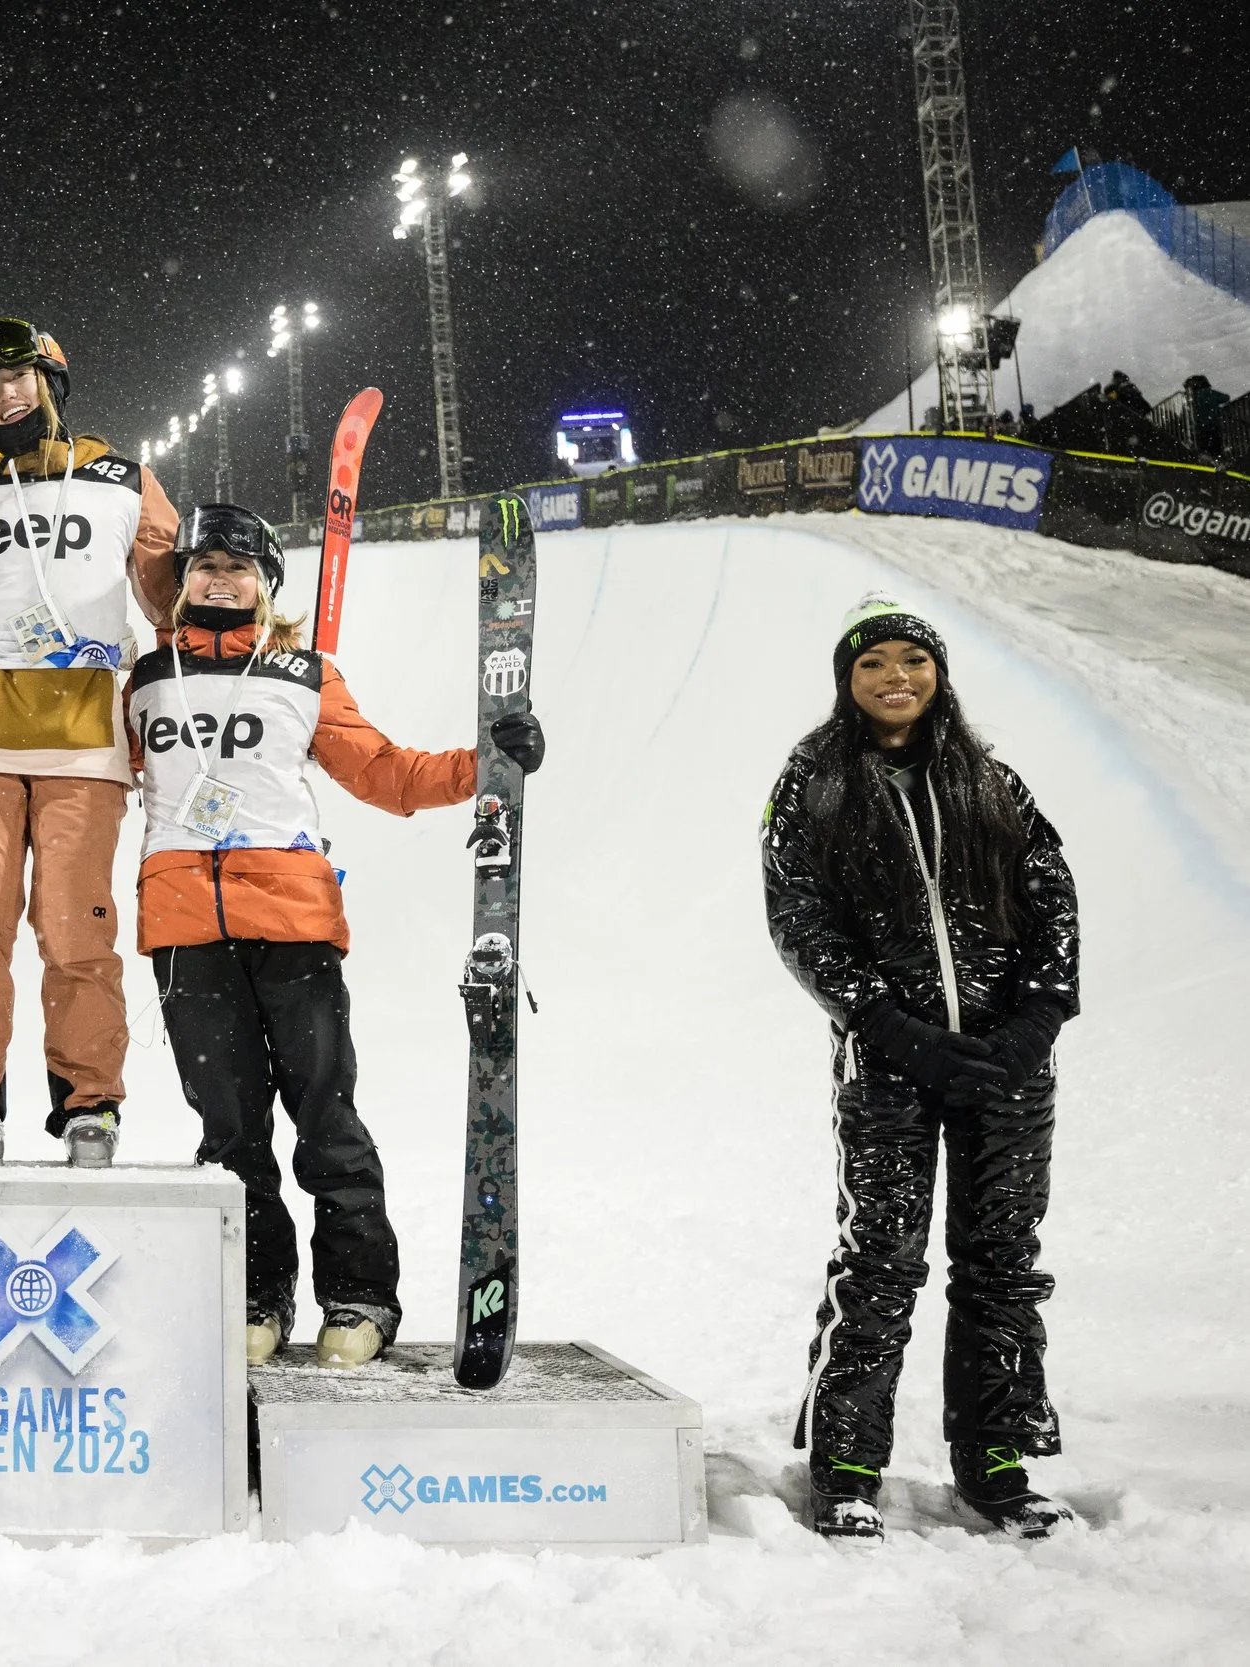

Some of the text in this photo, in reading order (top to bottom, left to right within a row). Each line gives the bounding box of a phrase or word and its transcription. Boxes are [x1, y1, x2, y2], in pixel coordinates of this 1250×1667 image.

[901, 454, 1044, 514] GAMES
[330, 489, 352, 522] OR
[327, 555, 339, 621] HEAD
[490, 661, 521, 670] YARD
[491, 655, 519, 663] RAIL
[196, 822, 221, 837] ASPEN
[93, 906, 106, 918] OR
[472, 1279, 505, 1325] K2
[53, 1429, 150, 1474] 2023
